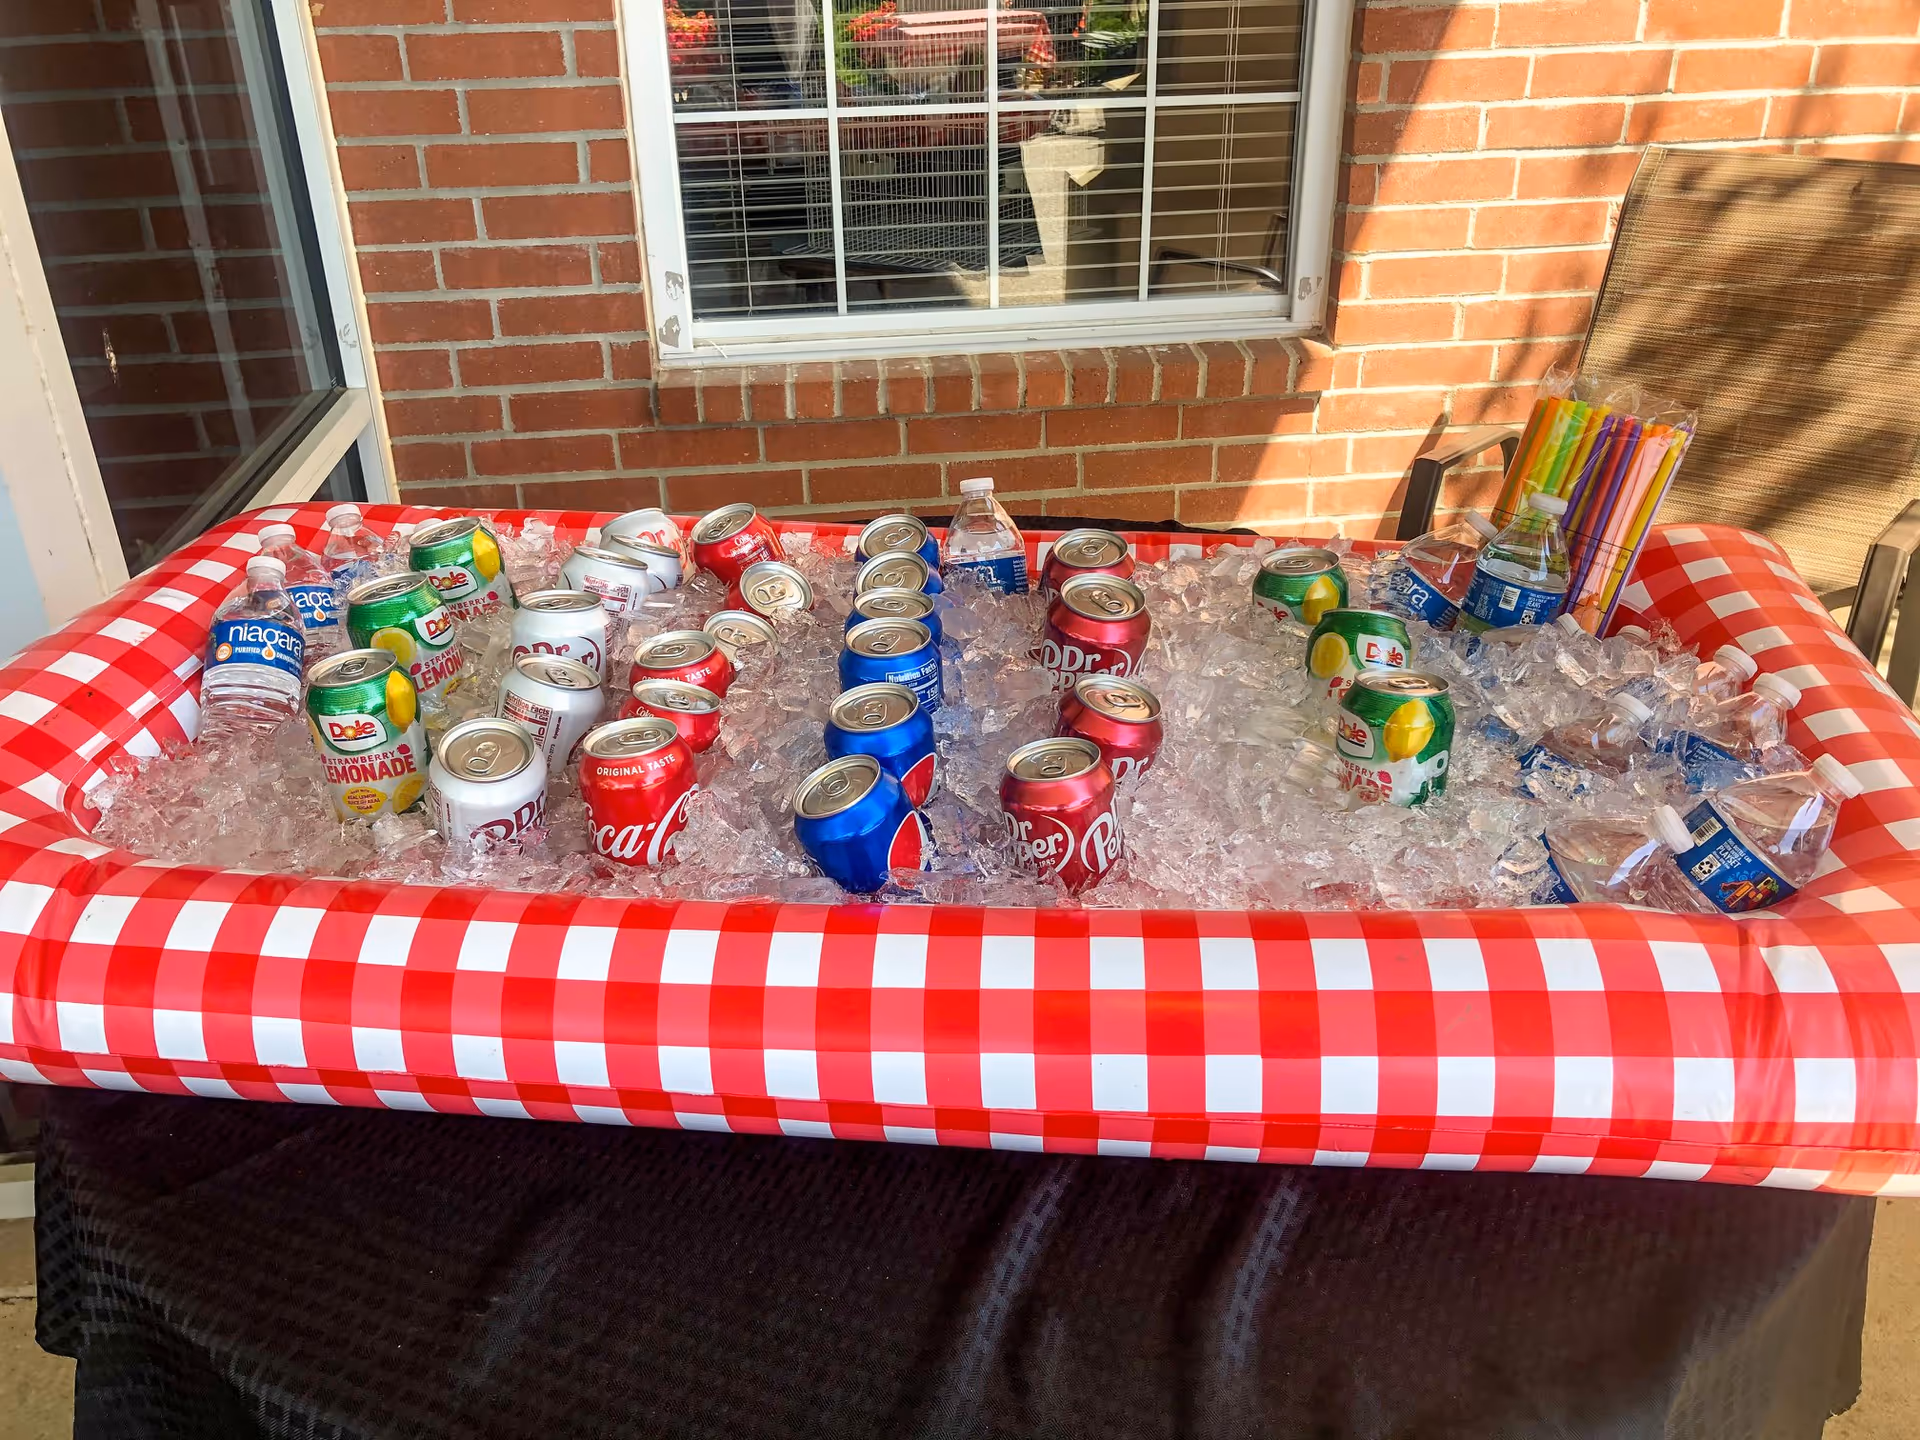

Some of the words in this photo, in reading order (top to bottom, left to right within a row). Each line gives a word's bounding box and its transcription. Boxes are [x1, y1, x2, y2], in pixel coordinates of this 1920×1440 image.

[428, 571, 468, 589] Dole
[449, 596, 486, 610] WBERRY
[228, 624, 303, 658] niagara
[1365, 642, 1404, 666] Dole
[684, 666, 712, 682] TASTE
[888, 671, 921, 683] Nutrition
[920, 661, 937, 676] Facts
[530, 704, 550, 717] Facts
[328, 719, 377, 740] Dole
[1339, 713, 1368, 744] Dole
[322, 753, 417, 785] LEMONADE
[327, 750, 395, 766] STRAWBERRY
[596, 766, 645, 777] ORIGINAL
[646, 754, 676, 772] TASTE
[1716, 844, 1742, 869] PLAYSET
